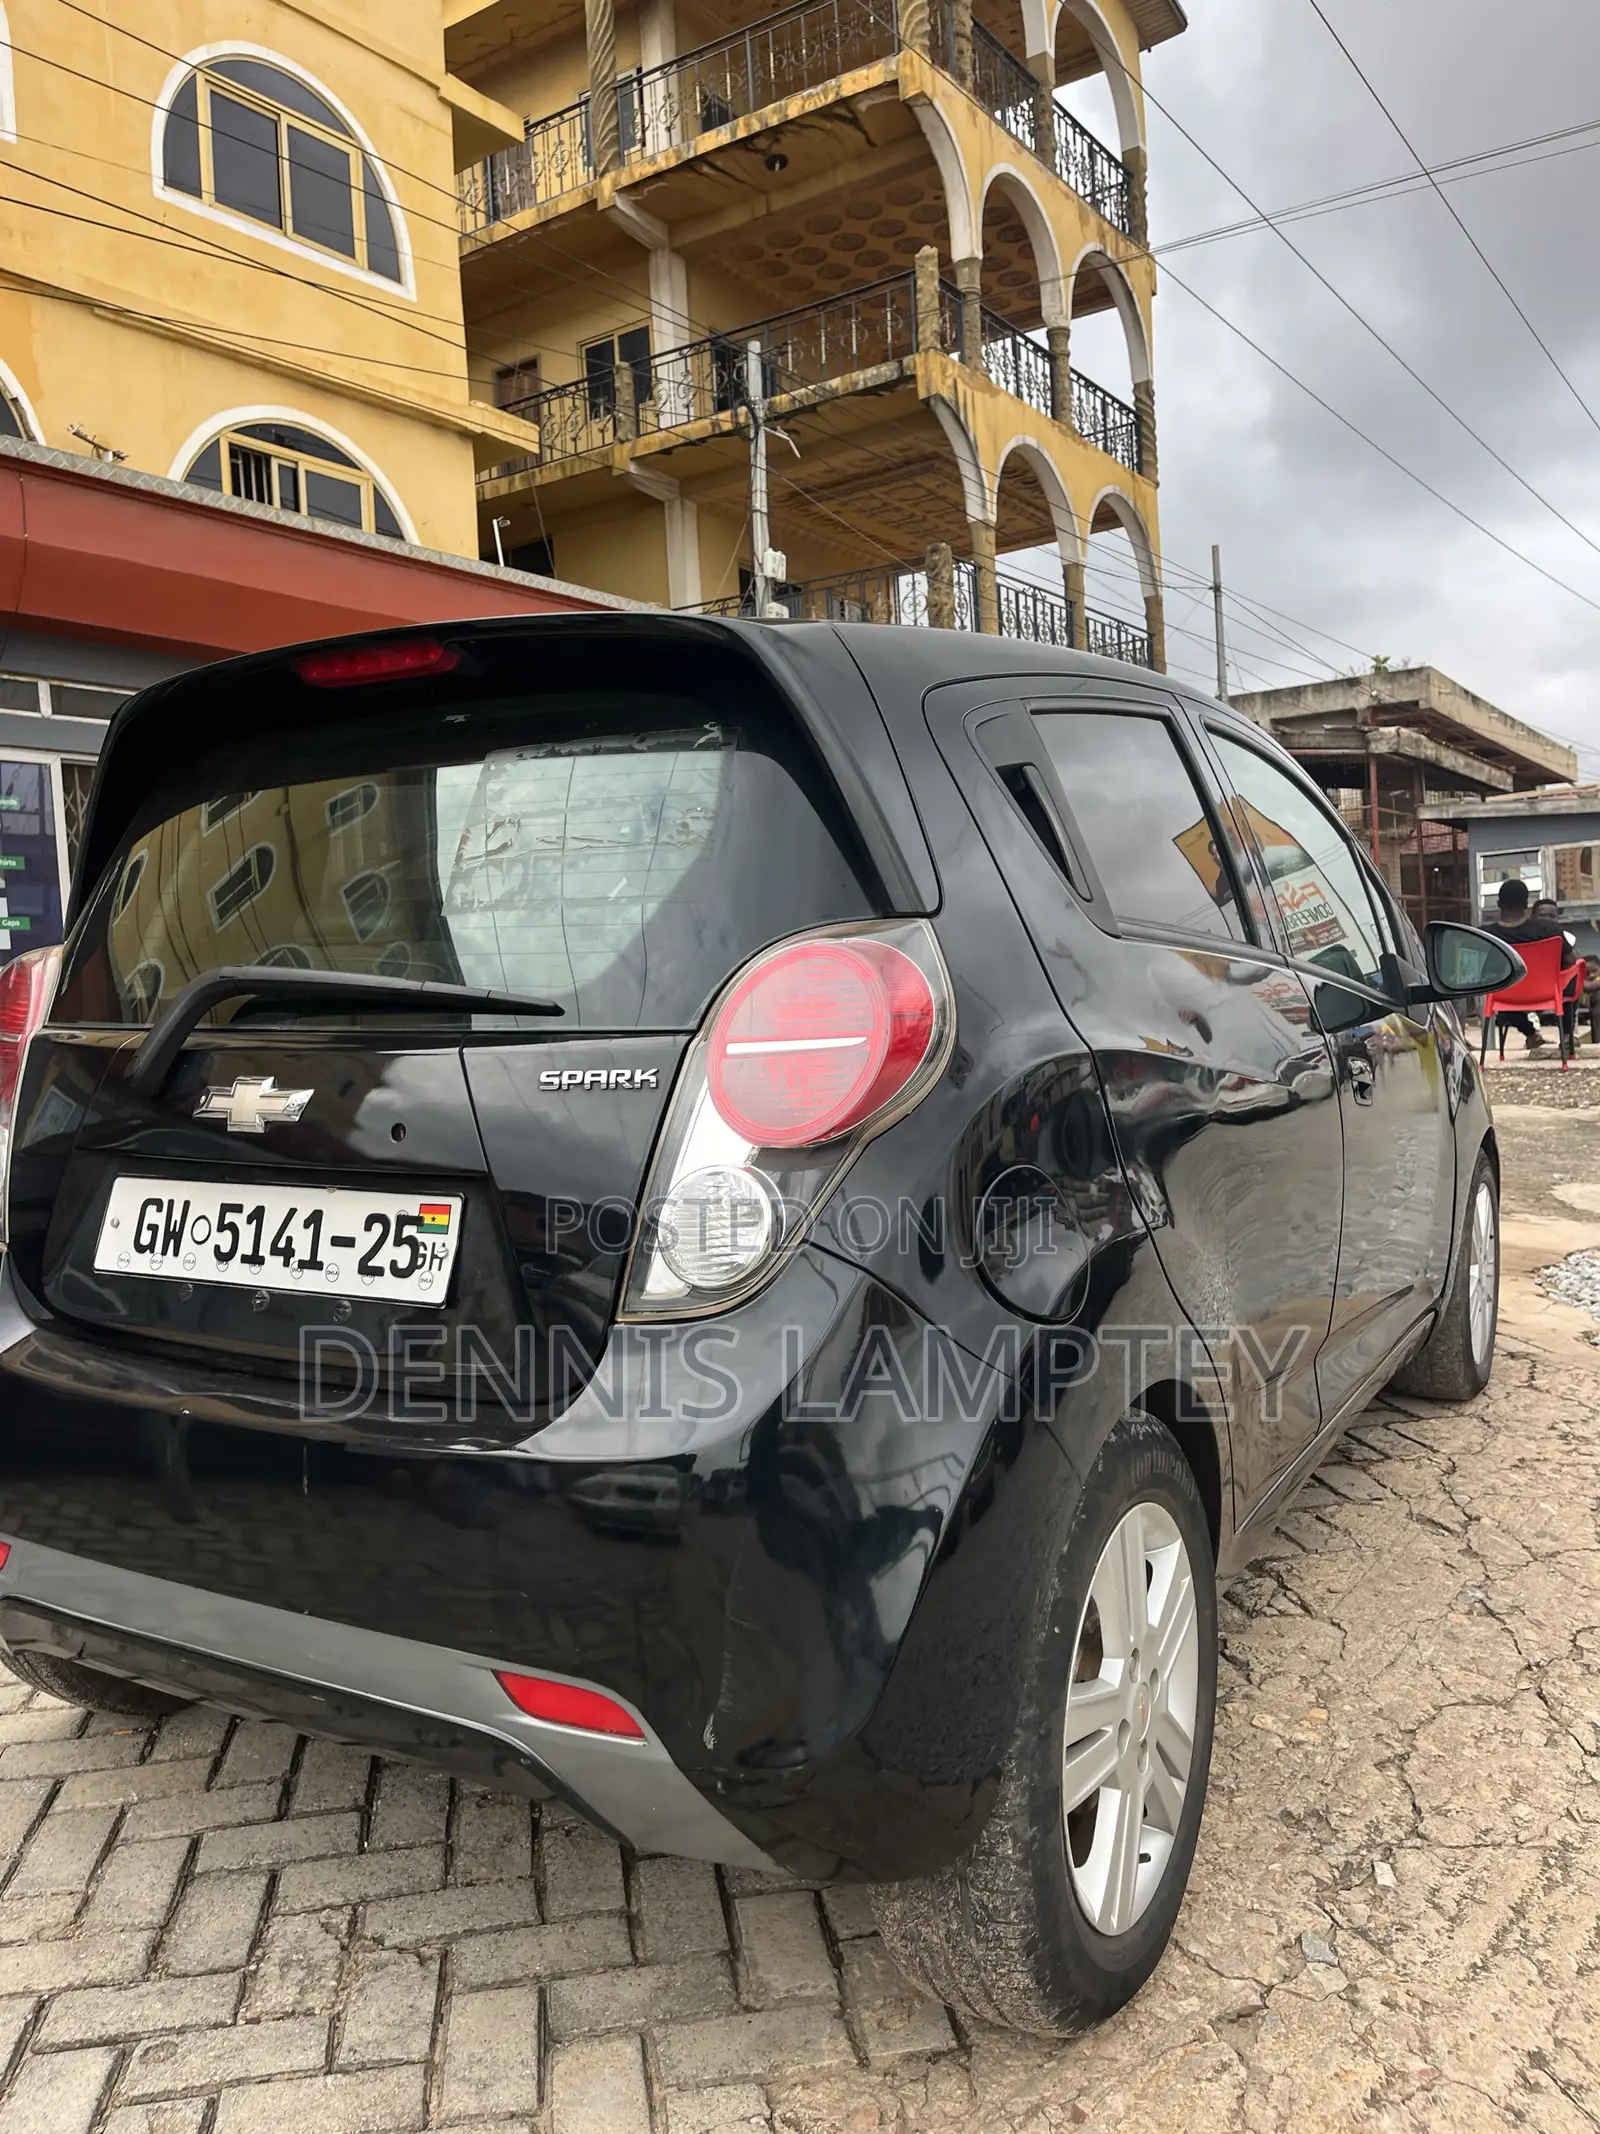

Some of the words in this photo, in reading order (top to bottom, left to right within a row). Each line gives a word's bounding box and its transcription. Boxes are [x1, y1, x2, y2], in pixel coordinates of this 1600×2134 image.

[539, 1068, 660, 1091] SPARK
[132, 1197, 191, 1257] GW
[213, 1203, 425, 1279] 5141-25
[415, 1241, 446, 1272] GH
